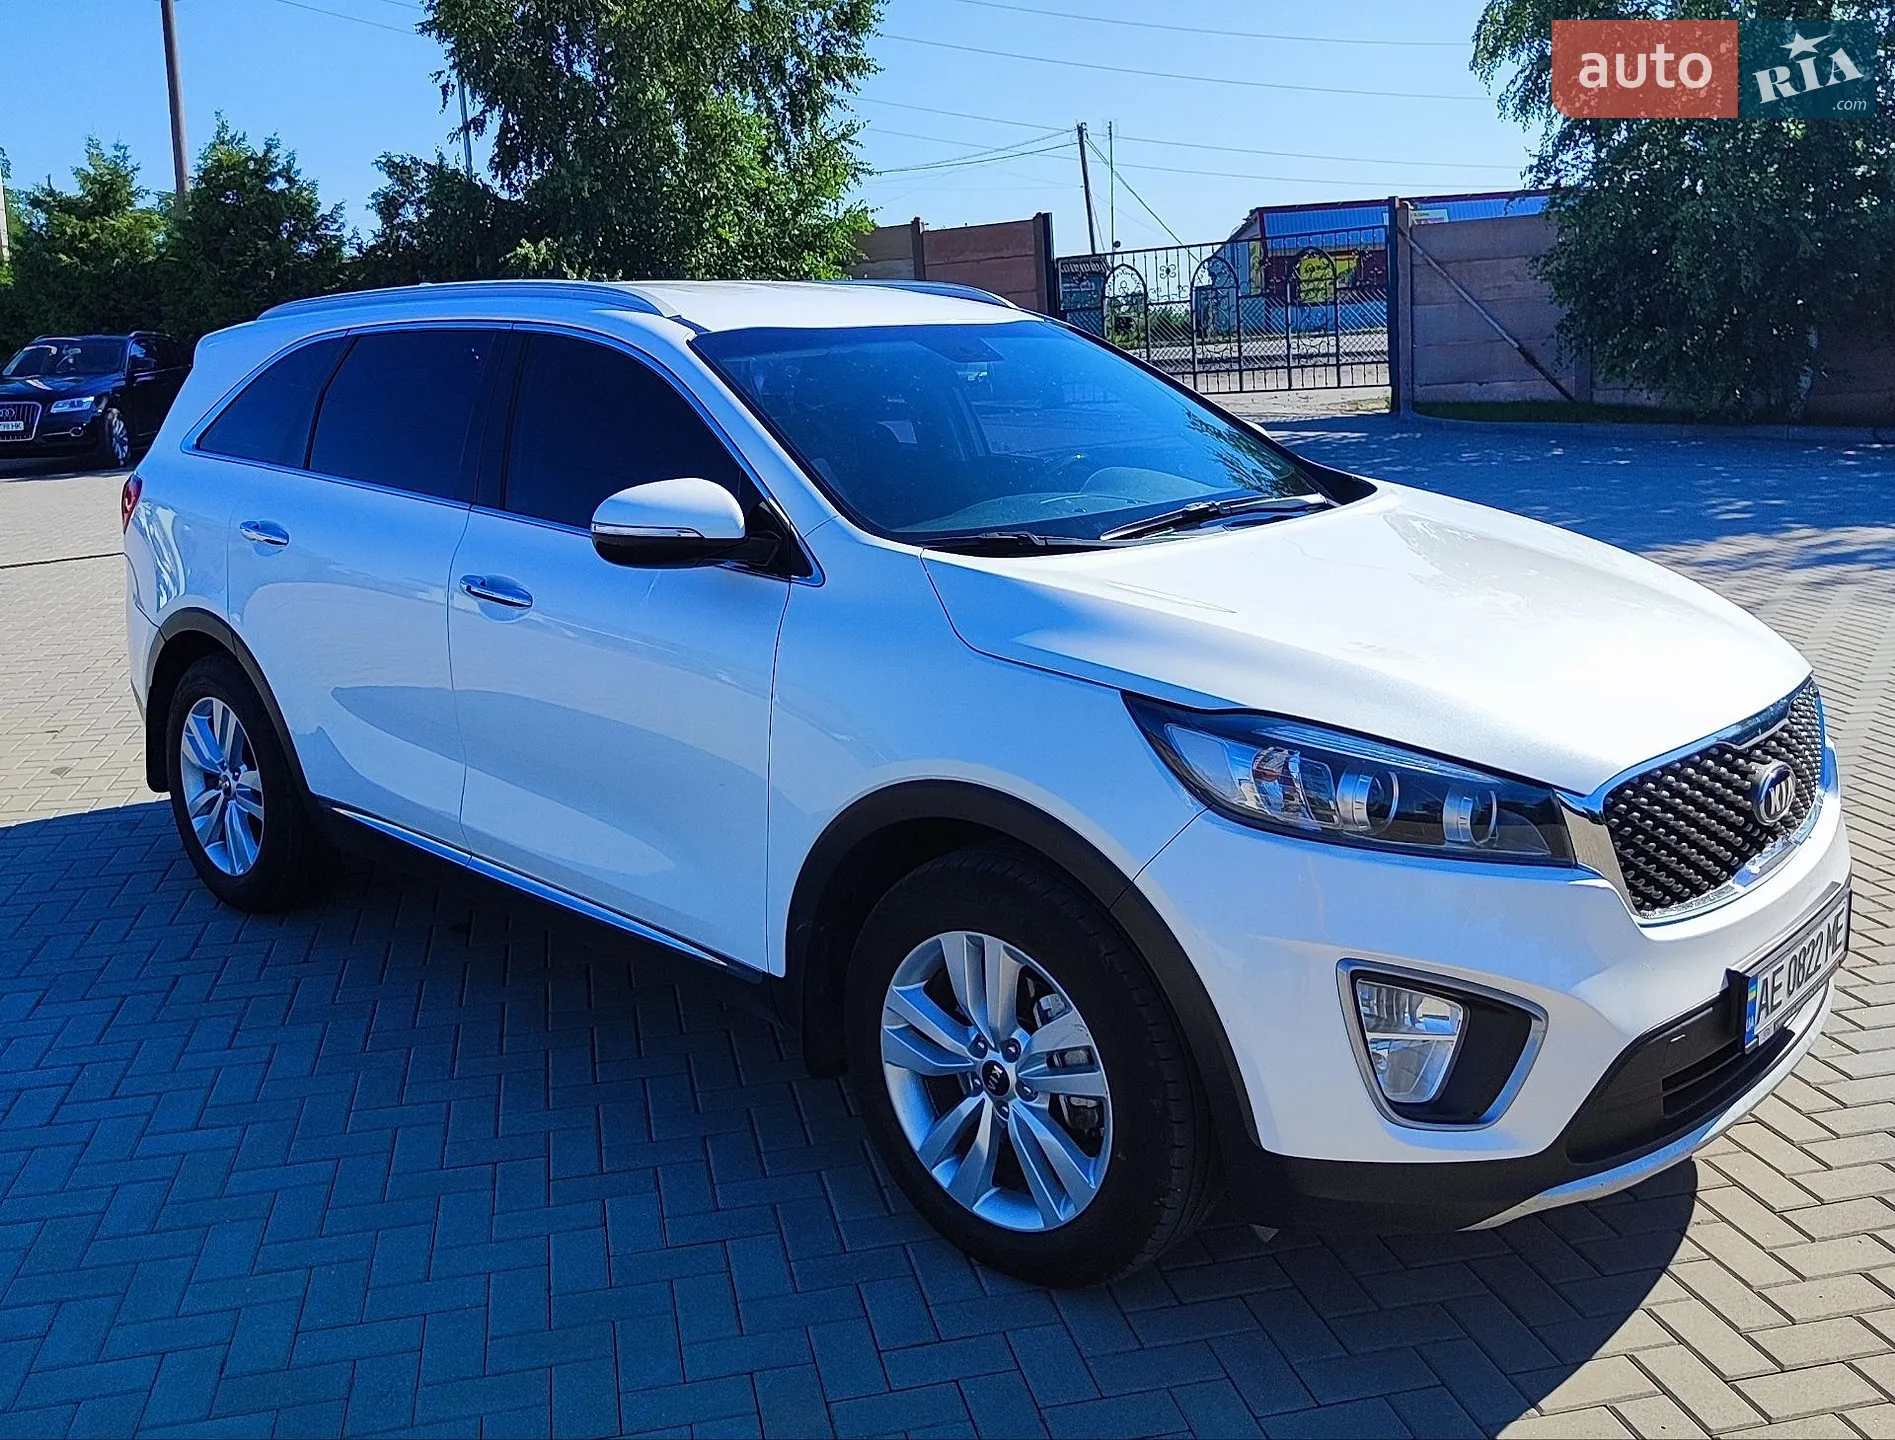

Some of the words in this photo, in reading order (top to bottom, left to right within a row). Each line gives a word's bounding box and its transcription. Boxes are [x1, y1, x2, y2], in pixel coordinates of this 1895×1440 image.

[1758, 964, 1785, 1025] AE
[1787, 931, 1824, 997] 0822
[987, 1065, 1003, 1091] KIA
